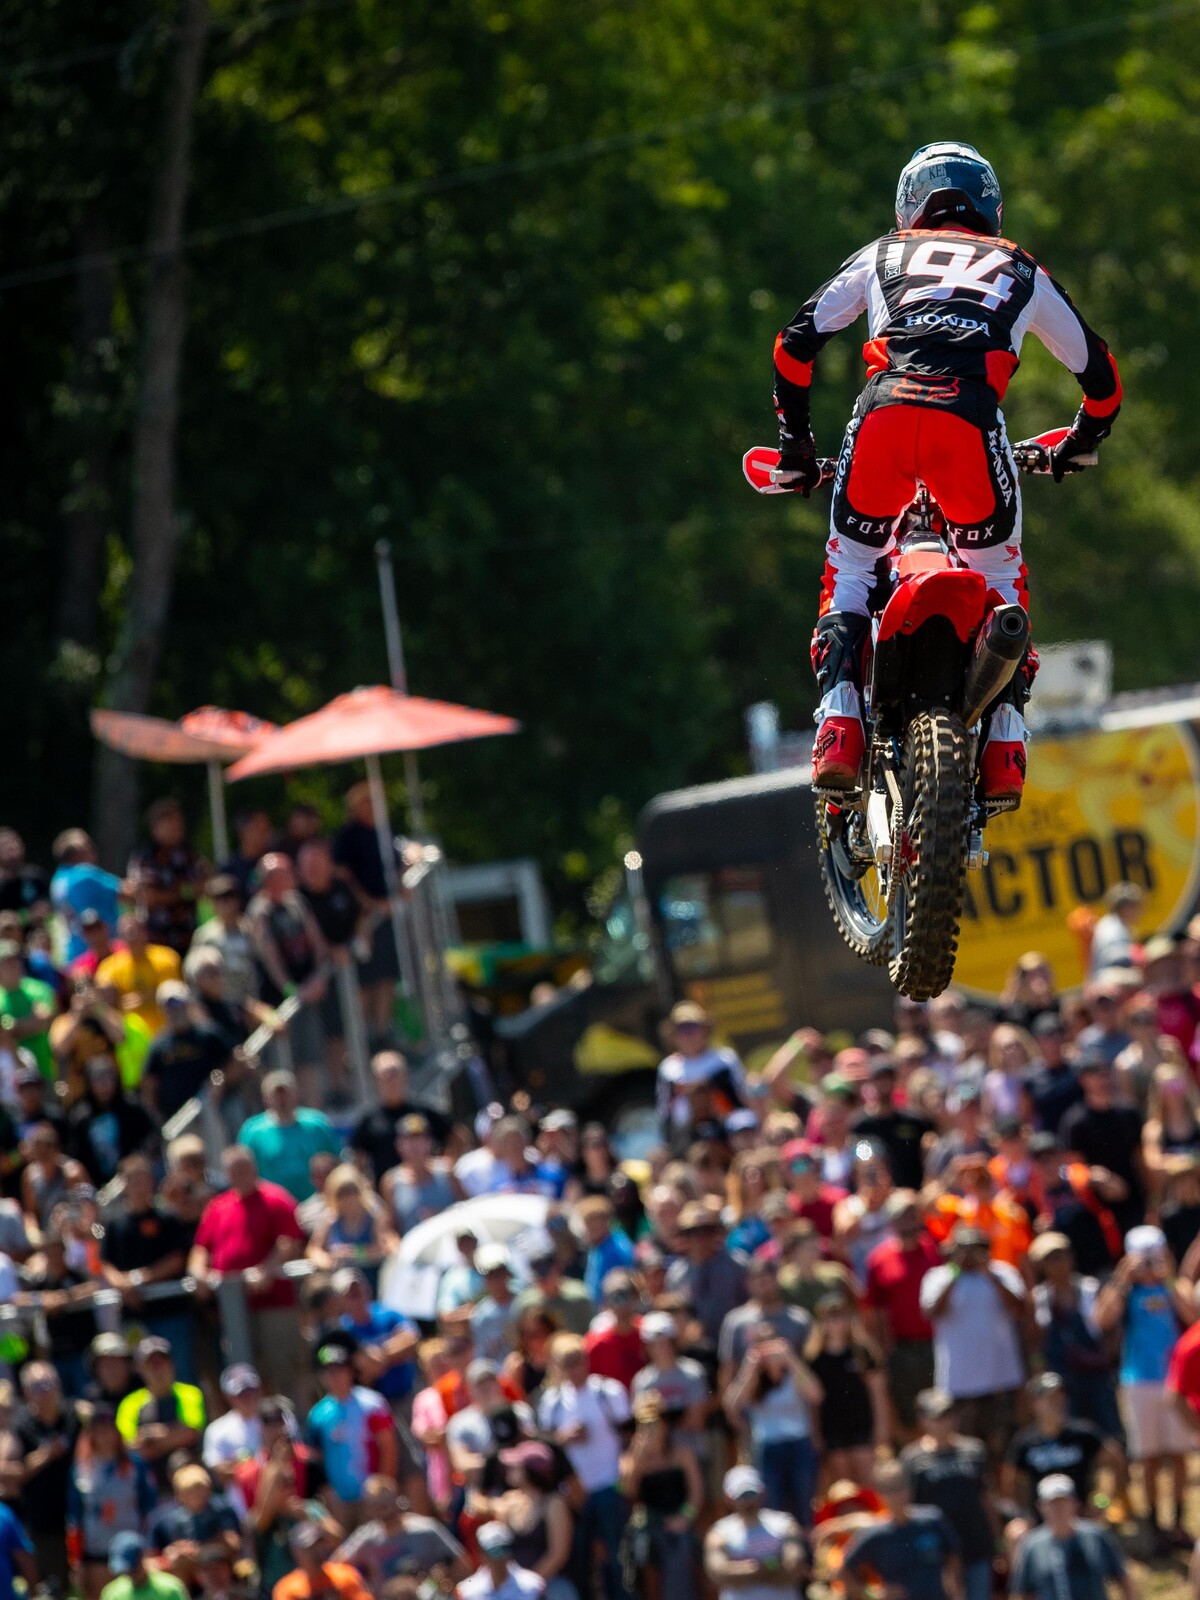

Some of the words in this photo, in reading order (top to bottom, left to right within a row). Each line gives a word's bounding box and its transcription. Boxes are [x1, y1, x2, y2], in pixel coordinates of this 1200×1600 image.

[899, 241, 1016, 312] 94
[904, 314, 991, 337] HONDA
[846, 516, 888, 534] FOX
[953, 524, 995, 541] FOX
